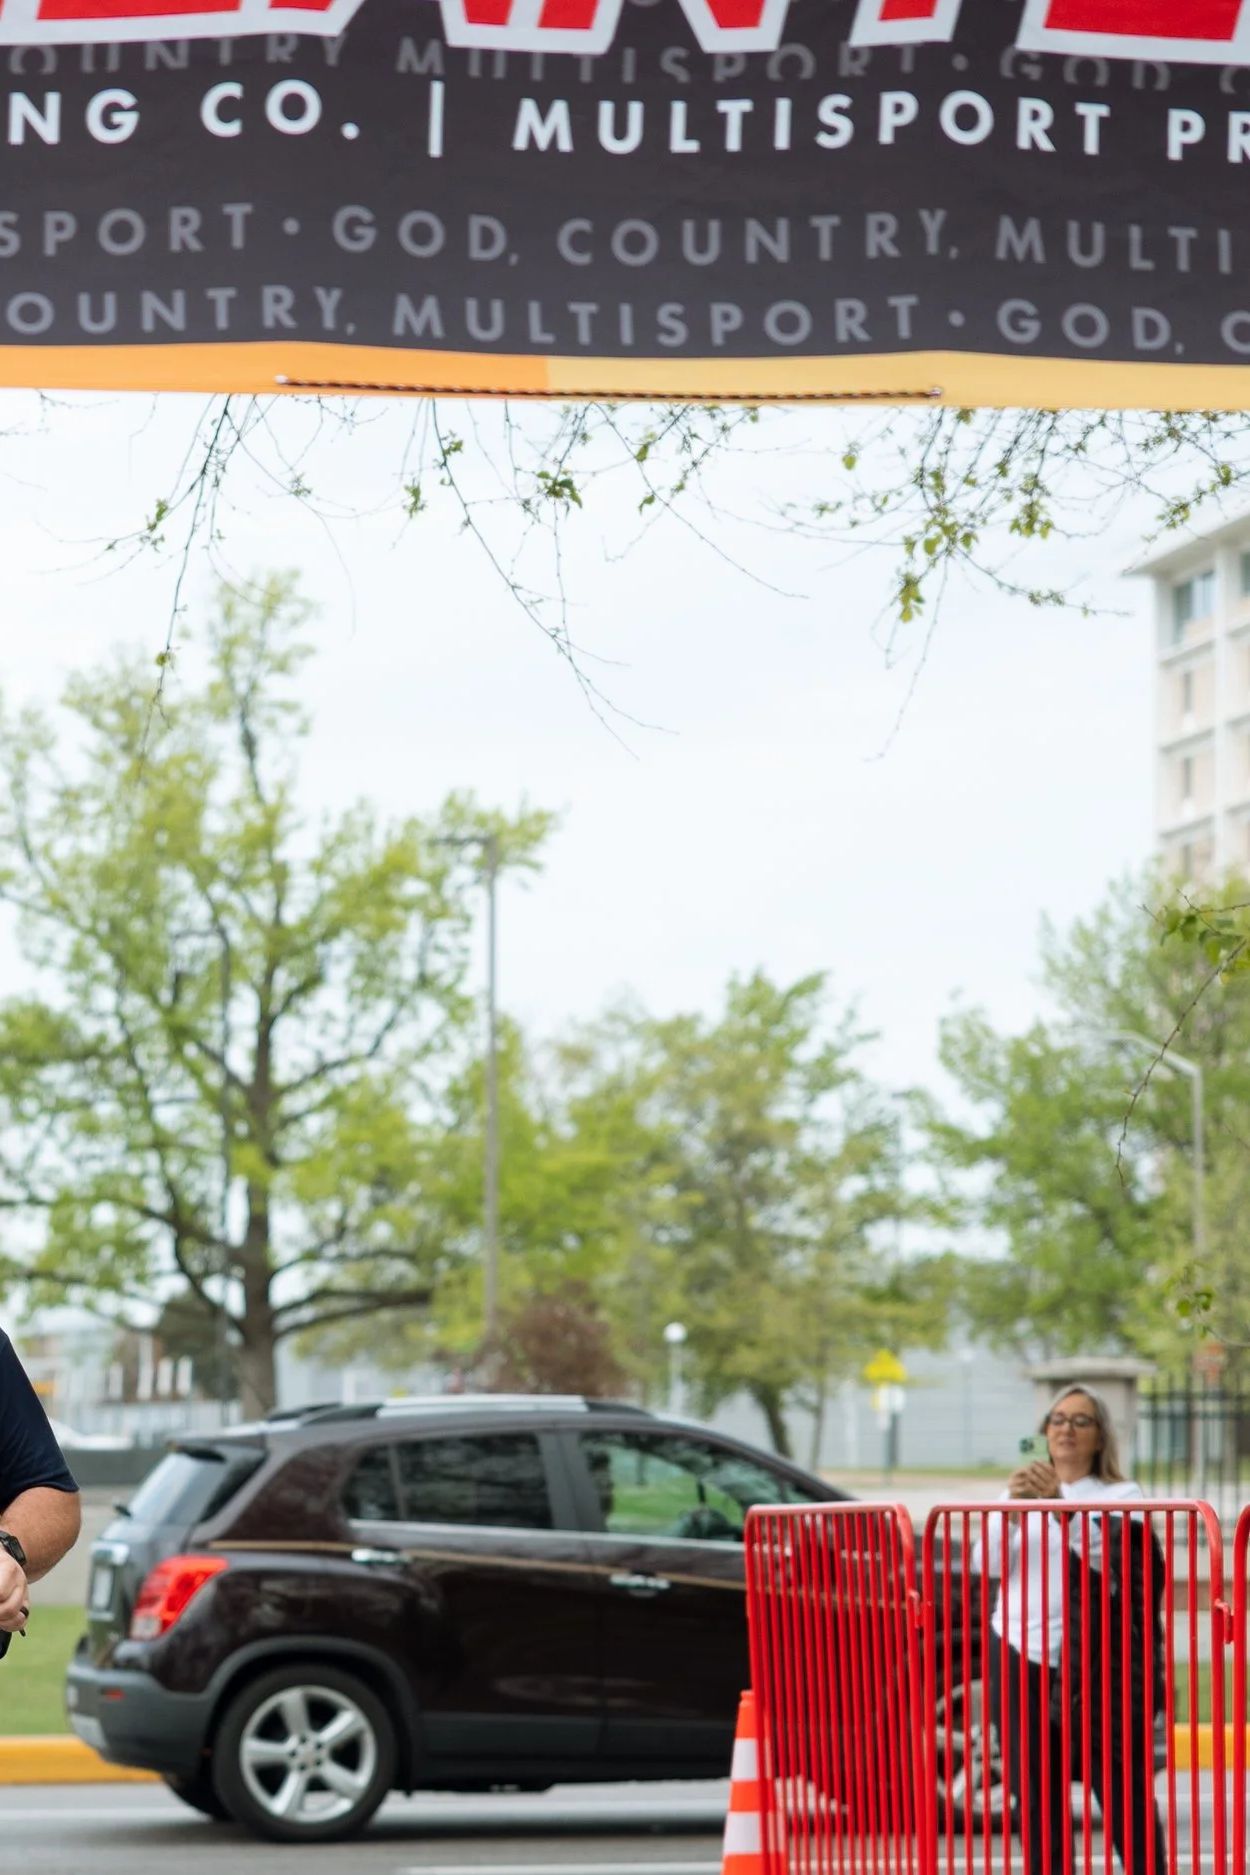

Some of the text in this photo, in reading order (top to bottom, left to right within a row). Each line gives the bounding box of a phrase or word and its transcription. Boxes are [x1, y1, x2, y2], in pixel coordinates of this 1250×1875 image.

[200, 79, 360, 140] CO.
[513, 90, 1110, 155] MULTISPORT
[332, 204, 519, 266] GOD,
[556, 209, 958, 267] COUNTRY,
[392, 293, 920, 348] MULTISPORT
[996, 298, 1185, 356] GOD,
